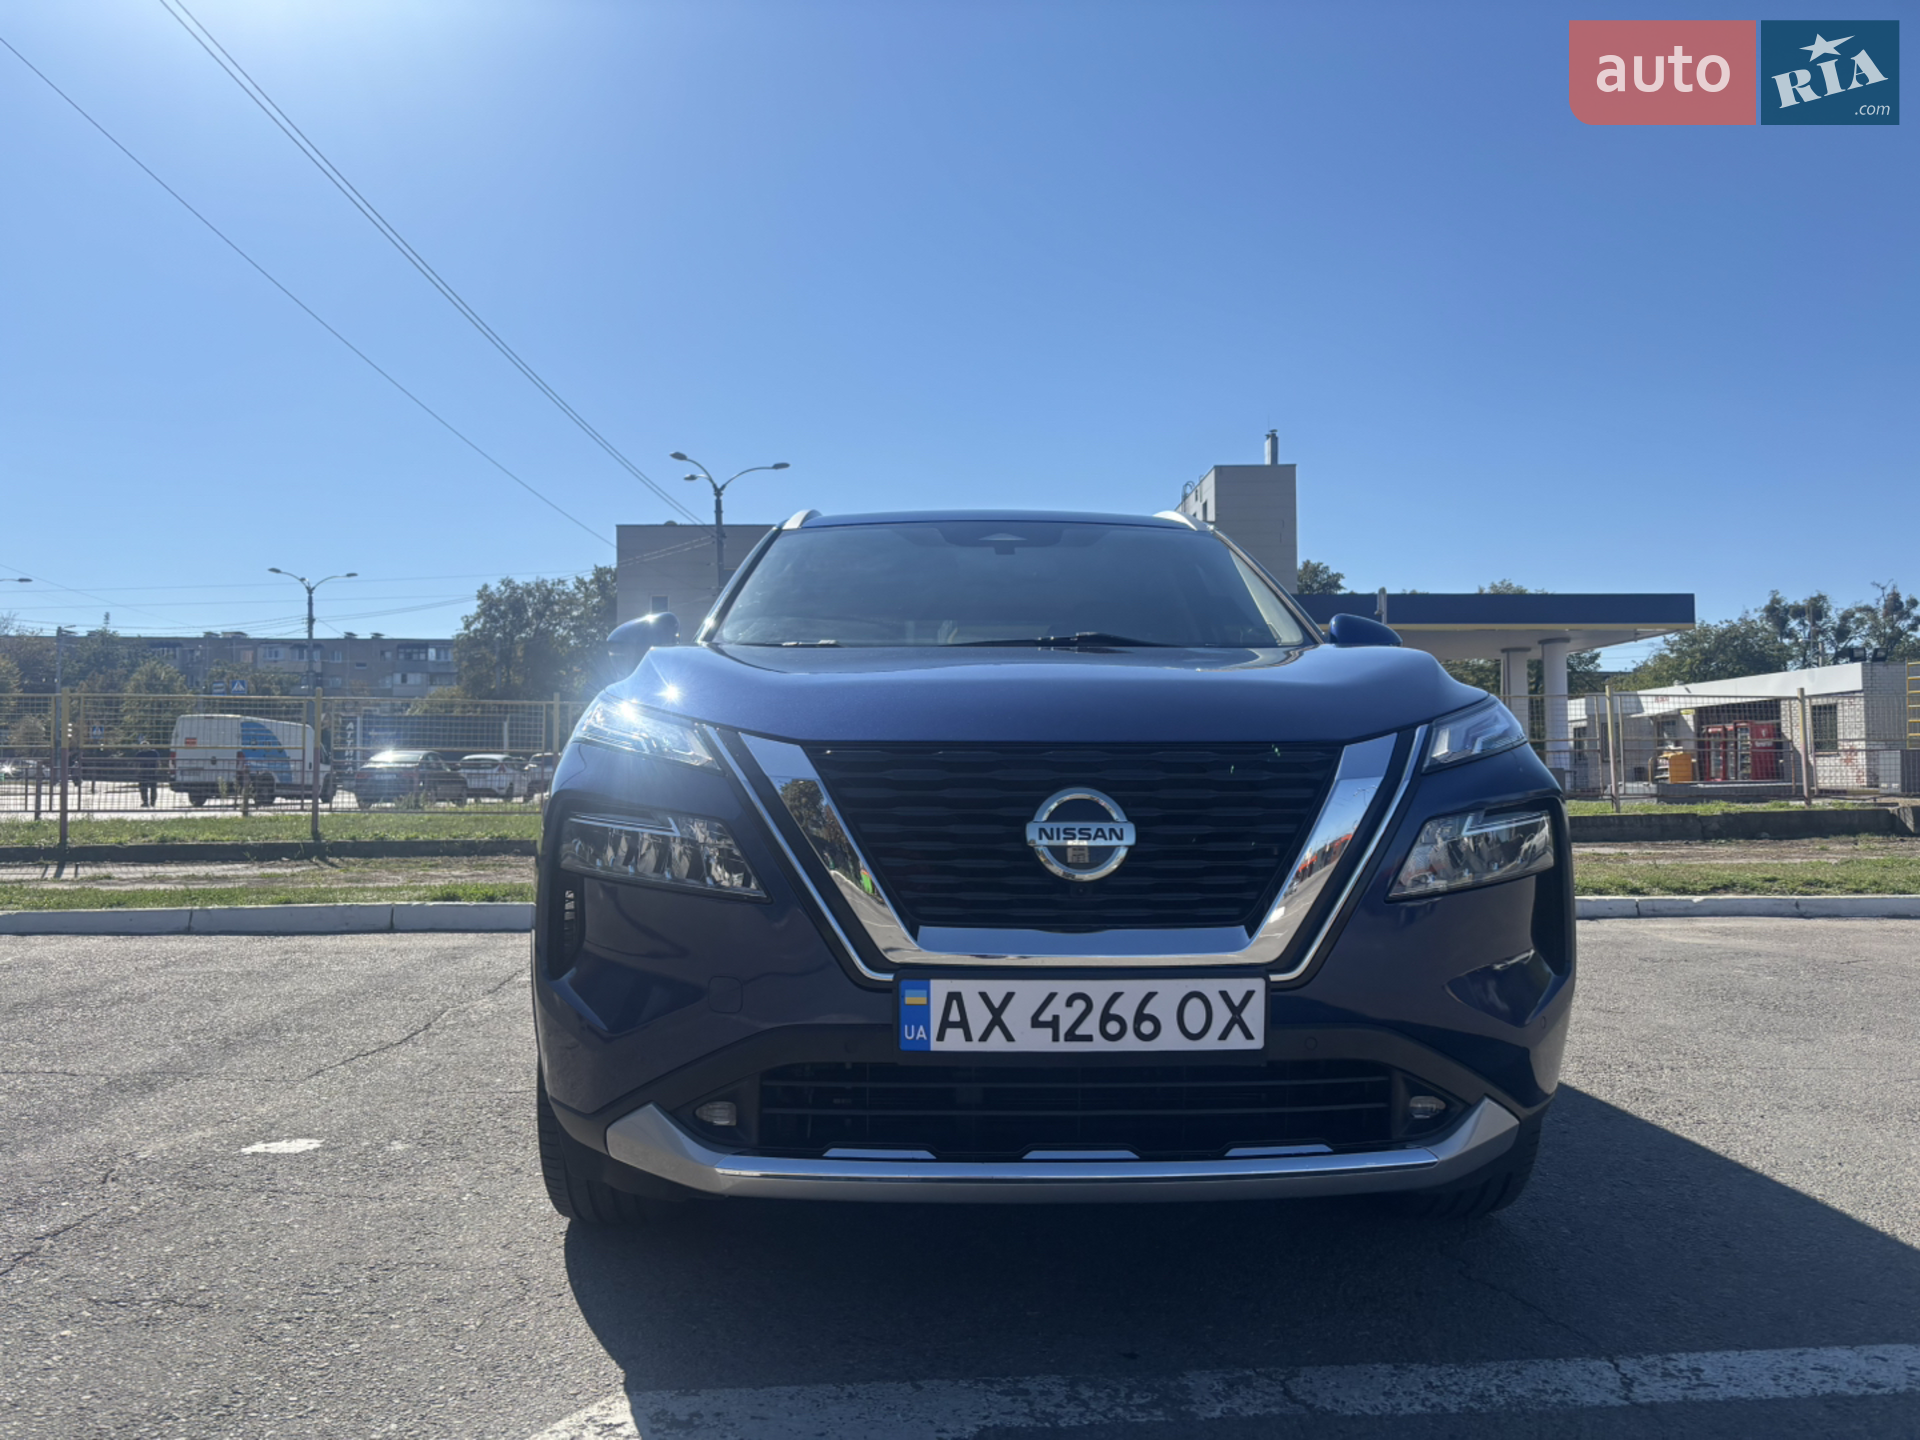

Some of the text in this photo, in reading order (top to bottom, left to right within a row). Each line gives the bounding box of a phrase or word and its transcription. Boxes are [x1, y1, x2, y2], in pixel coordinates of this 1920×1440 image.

[1038, 827, 1124, 841] NISSAN
[935, 990, 1256, 1042] AX 4266 OX
[904, 1024, 928, 1040] UA
